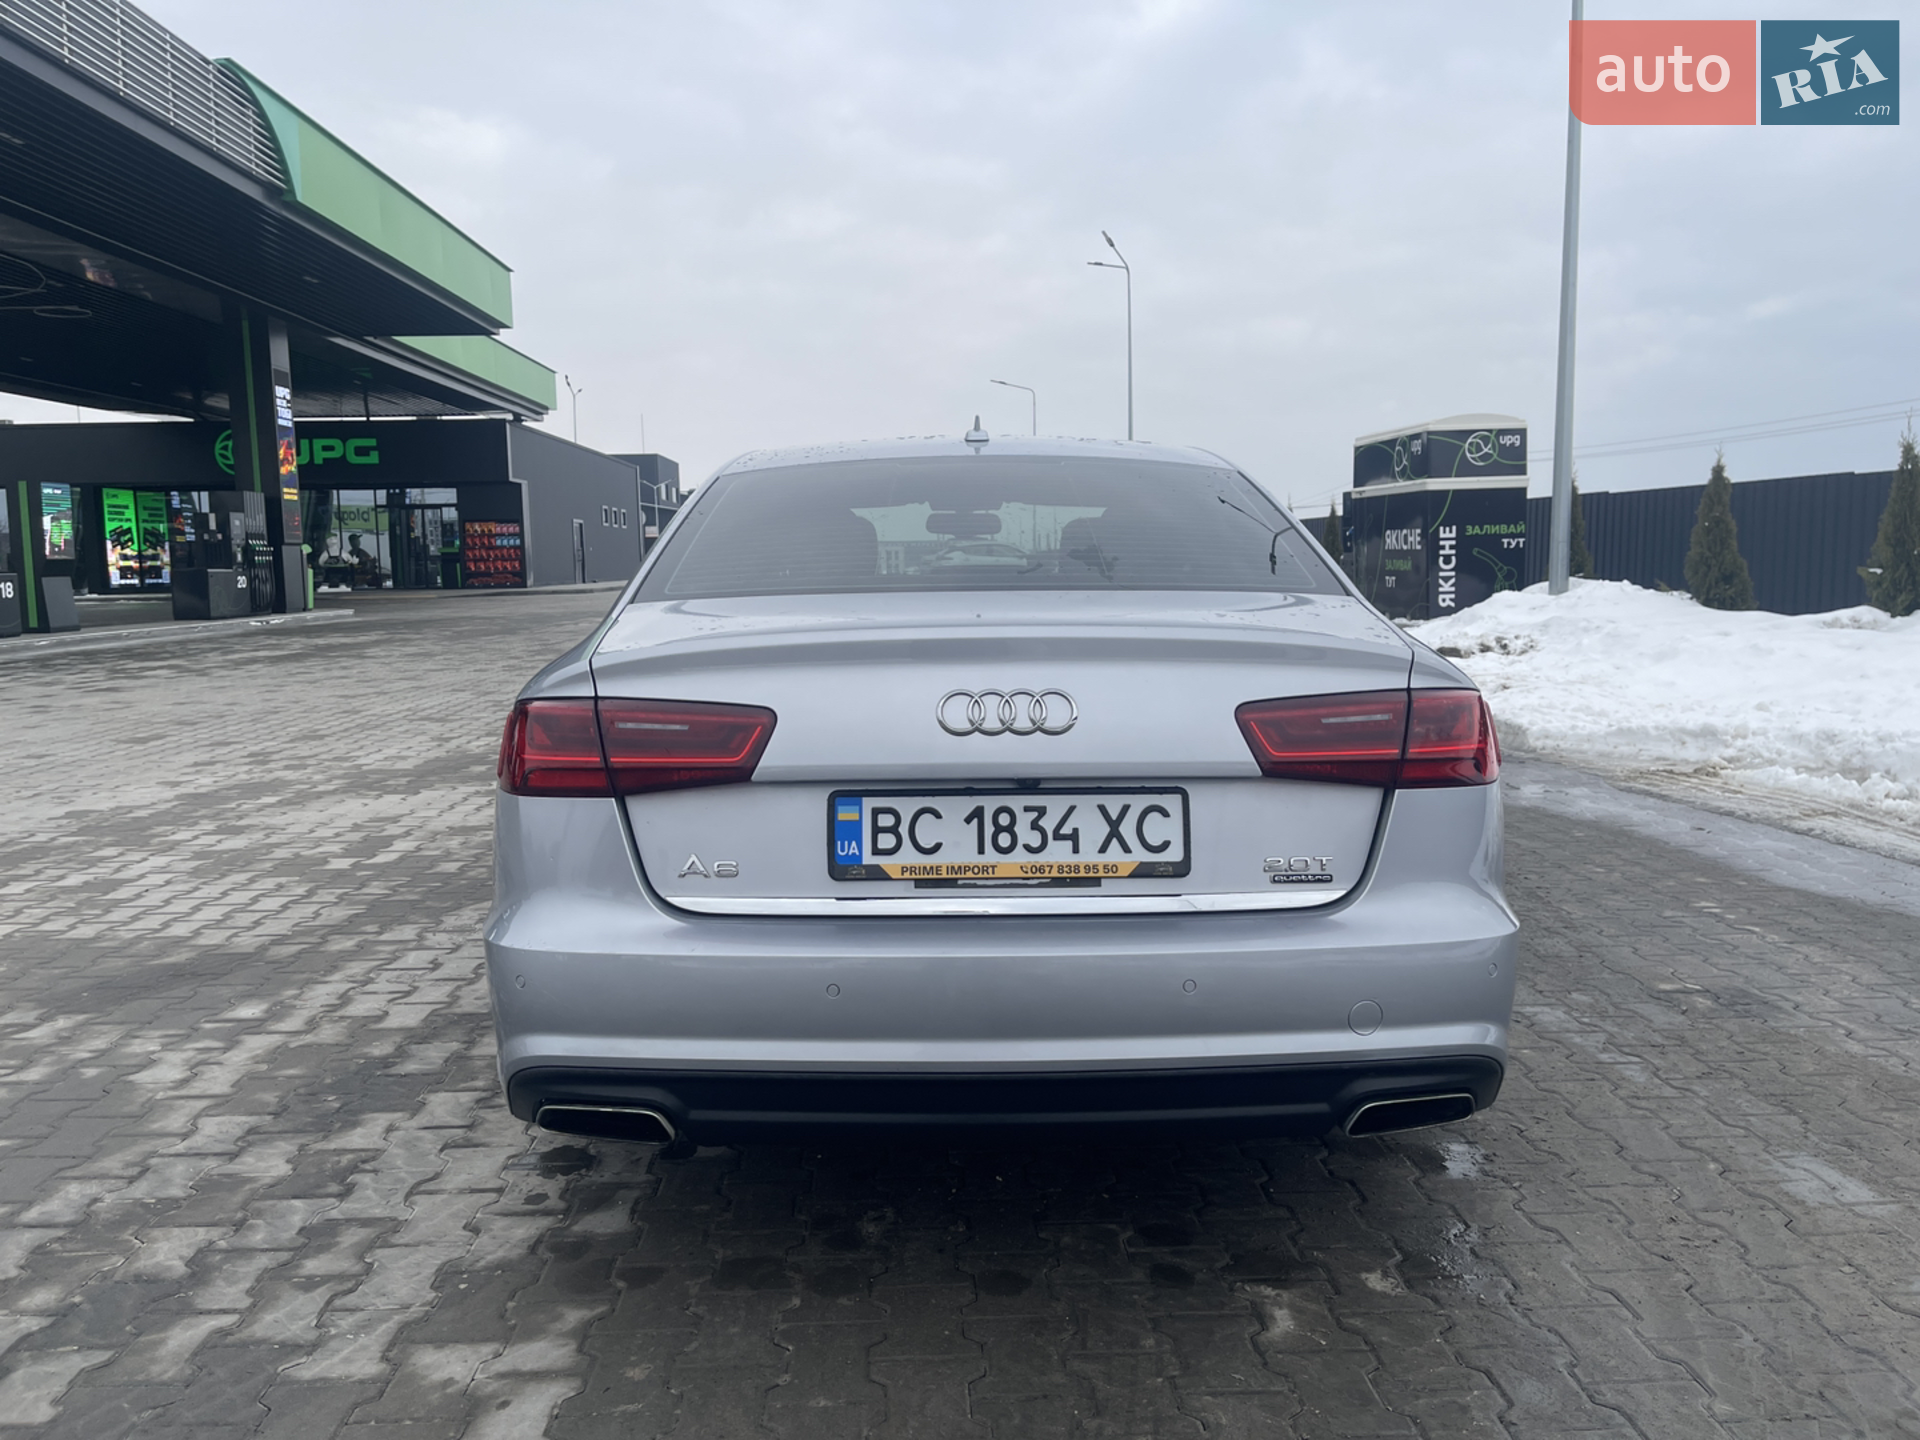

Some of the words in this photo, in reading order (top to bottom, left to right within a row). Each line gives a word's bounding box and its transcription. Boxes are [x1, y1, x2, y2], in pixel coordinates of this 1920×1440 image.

[1410, 439, 1422, 455] upg
[1499, 435, 1521, 447] upg
[1465, 521, 1526, 535] ЗАЛИВАЙ
[1384, 528, 1422, 551] ЯКІСНЕ
[1501, 538, 1526, 549] ТУТ
[1438, 525, 1457, 608] ЯКІСНЕ
[237, 575, 248, 588] 20
[0, 581, 14, 599] 18
[870, 806, 944, 856] BC
[963, 804, 1080, 856] 1834
[1096, 803, 1172, 854] XC
[837, 841, 860, 856] UA
[677, 853, 740, 878] A6
[900, 865, 943, 877] PRIME
[946, 864, 998, 876] IMPORT
[1030, 864, 1054, 875] 067
[1056, 864, 1081, 875] 838
[1083, 864, 1100, 875] 95
[1103, 863, 1118, 875] 50
[1263, 856, 1334, 873] 2.0T
[1274, 874, 1331, 882] quattro
